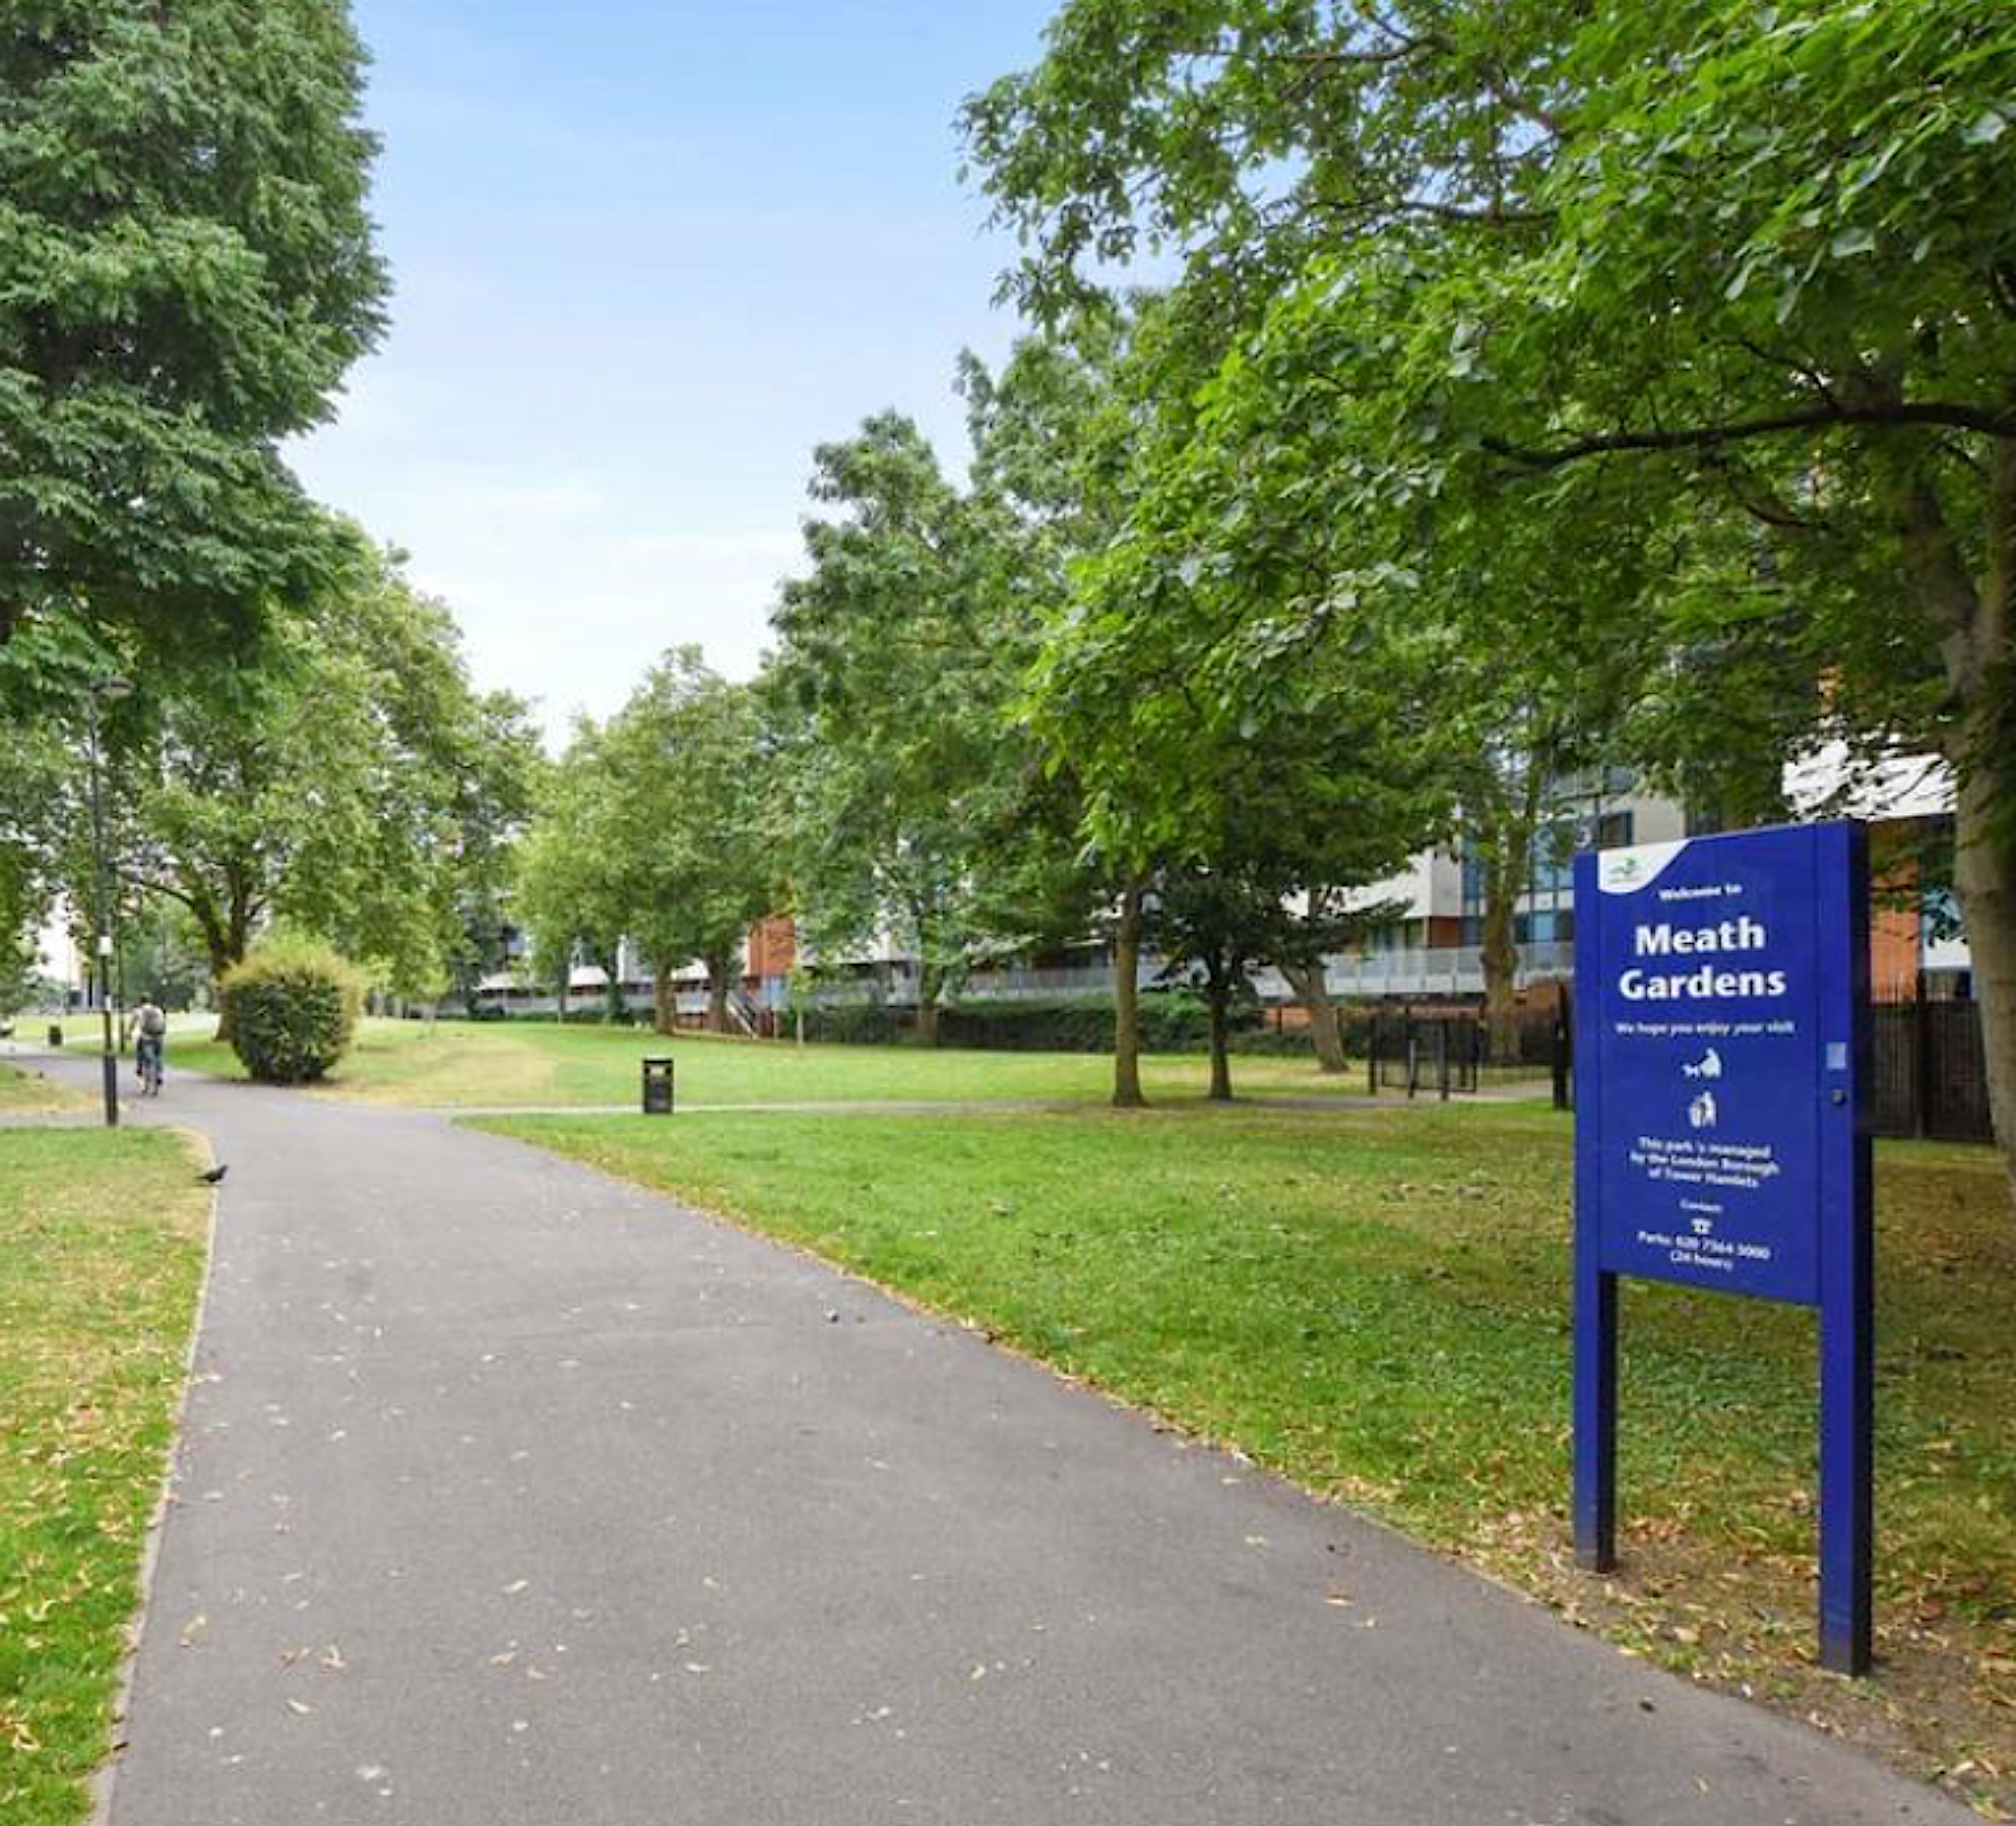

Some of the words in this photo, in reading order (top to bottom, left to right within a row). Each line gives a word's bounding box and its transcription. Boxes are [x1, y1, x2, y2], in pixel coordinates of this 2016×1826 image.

[1659, 885, 1722, 902] Welcome
[1725, 882, 1742, 895] to
[1635, 915, 1766, 956] Meath
[1619, 965, 1788, 1000] Gardens
[1615, 1022, 1634, 1034] We
[1637, 1021, 1668, 1037] hope
[1670, 1023, 1693, 1037] you
[1696, 1022, 1730, 1037] enjoy
[1733, 1022, 1764, 1037] your
[1767, 1020, 1796, 1034] visit
[1638, 1136, 1663, 1150] This
[1666, 1140, 1693, 1154] park
[1708, 1144, 1771, 1160] managed
[1630, 1151, 1646, 1164] by
[1648, 1153, 1670, 1165] the
[1670, 1155, 1719, 1167] London
[1721, 1158, 1780, 1176] Borough
[1648, 1166, 1662, 1178] of
[1665, 1167, 1702, 1181] Tower
[1704, 1171, 1759, 1188] Hamlets
